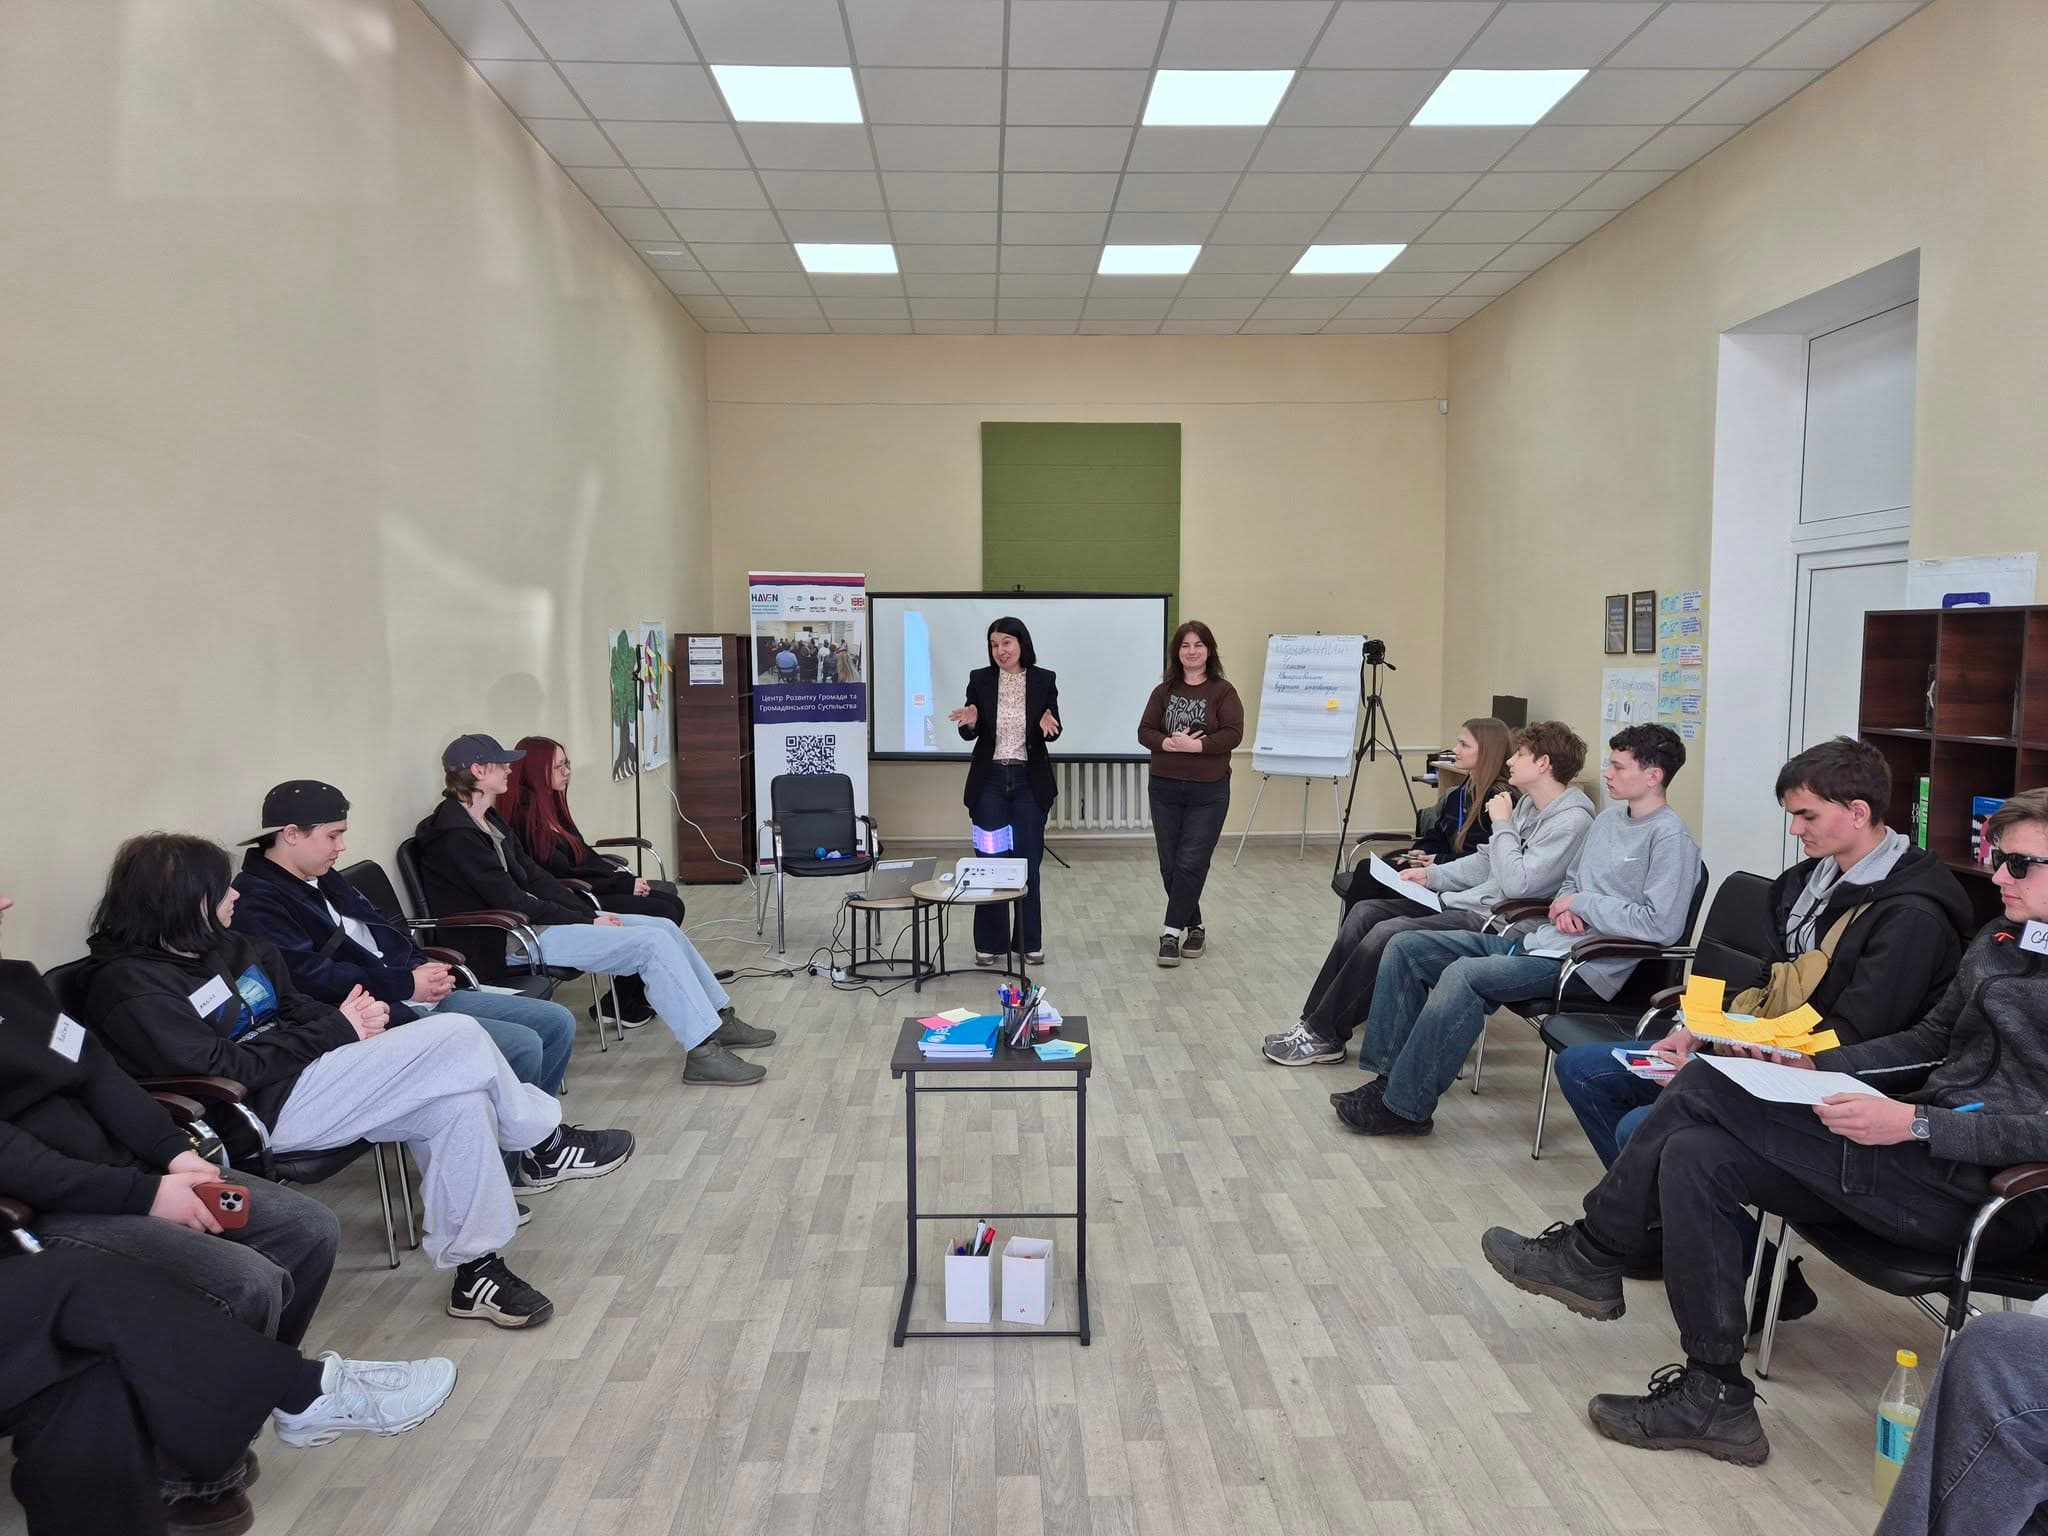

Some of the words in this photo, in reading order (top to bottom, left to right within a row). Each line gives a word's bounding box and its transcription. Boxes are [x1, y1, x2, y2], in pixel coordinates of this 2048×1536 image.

[751, 593, 779, 602] HAVEN
[761, 695, 784, 703] Центр
[786, 694, 817, 702] Розвитку
[818, 693, 848, 701] Громади
[759, 704, 816, 713] Громадянського
[817, 703, 857, 711] Суспільства
